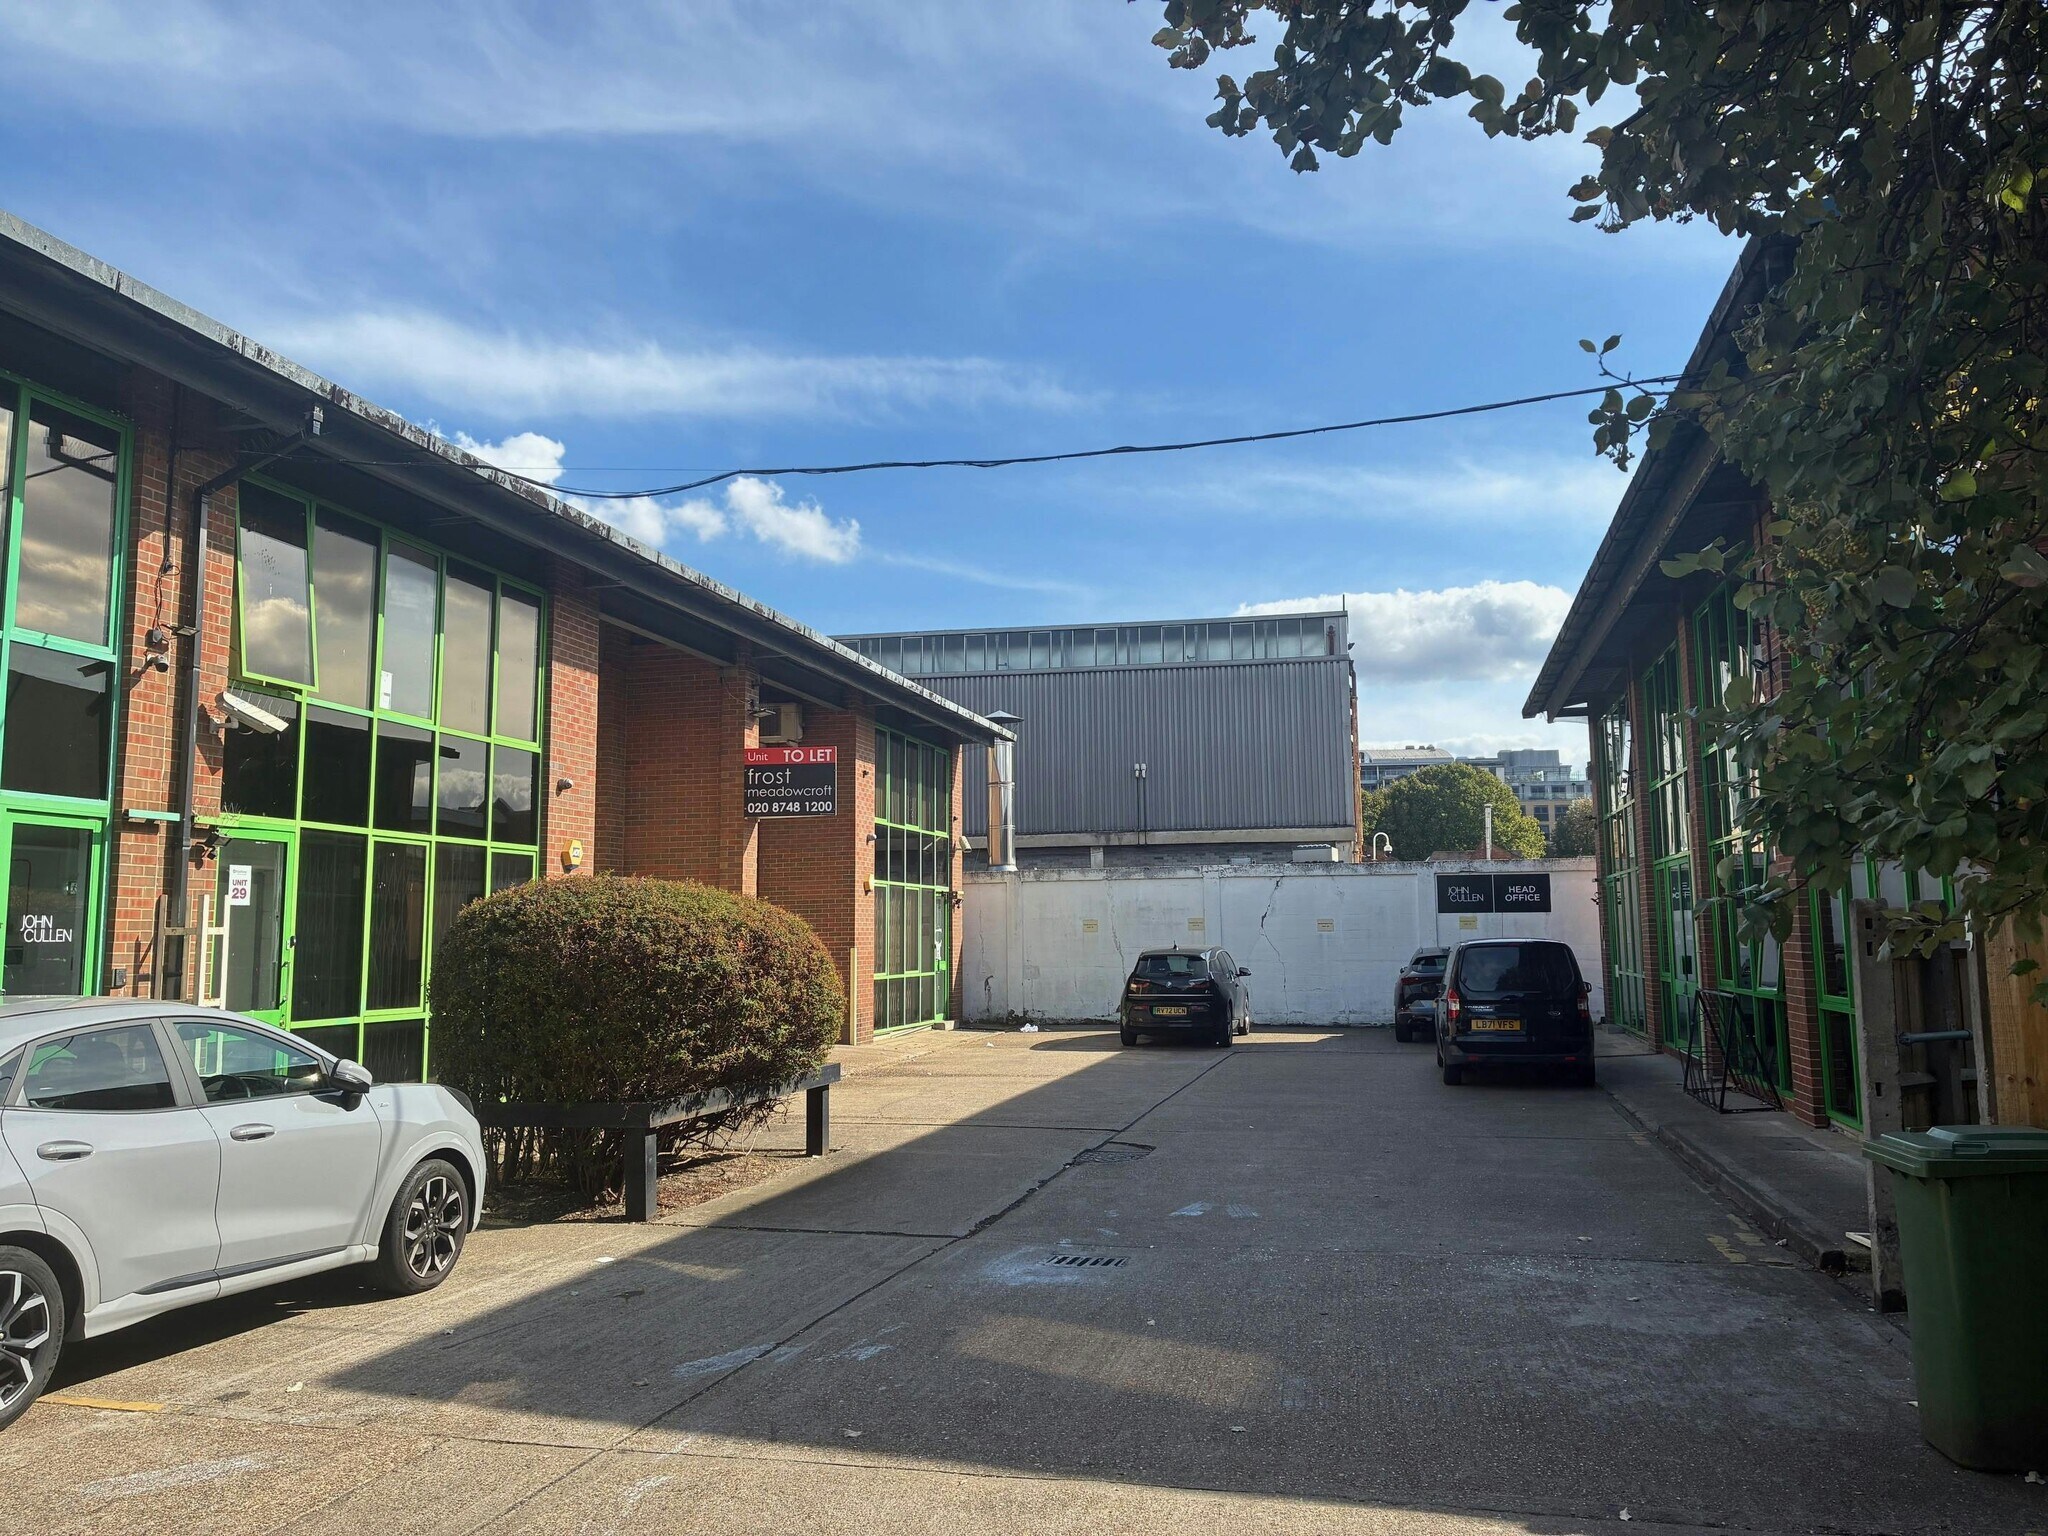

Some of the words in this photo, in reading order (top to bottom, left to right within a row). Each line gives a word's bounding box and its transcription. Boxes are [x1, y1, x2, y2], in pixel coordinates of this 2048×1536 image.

[747, 752, 768, 761] Unit
[783, 749, 804, 762] TO
[809, 749, 833, 762] LET
[747, 768, 792, 785] frost
[747, 785, 832, 797] meadowcroft
[747, 802, 769, 813] 020
[772, 801, 800, 812] 8748
[805, 801, 833, 812] 1200
[231, 887, 247, 899] 29
[1447, 886, 1469, 896] JOHN
[1508, 885, 1536, 893] HEAD
[1449, 893, 1484, 902] CULLEN
[1505, 893, 1541, 902] OFFICE
[20, 914, 53, 931] JOHN
[23, 928, 73, 943] CULLEN
